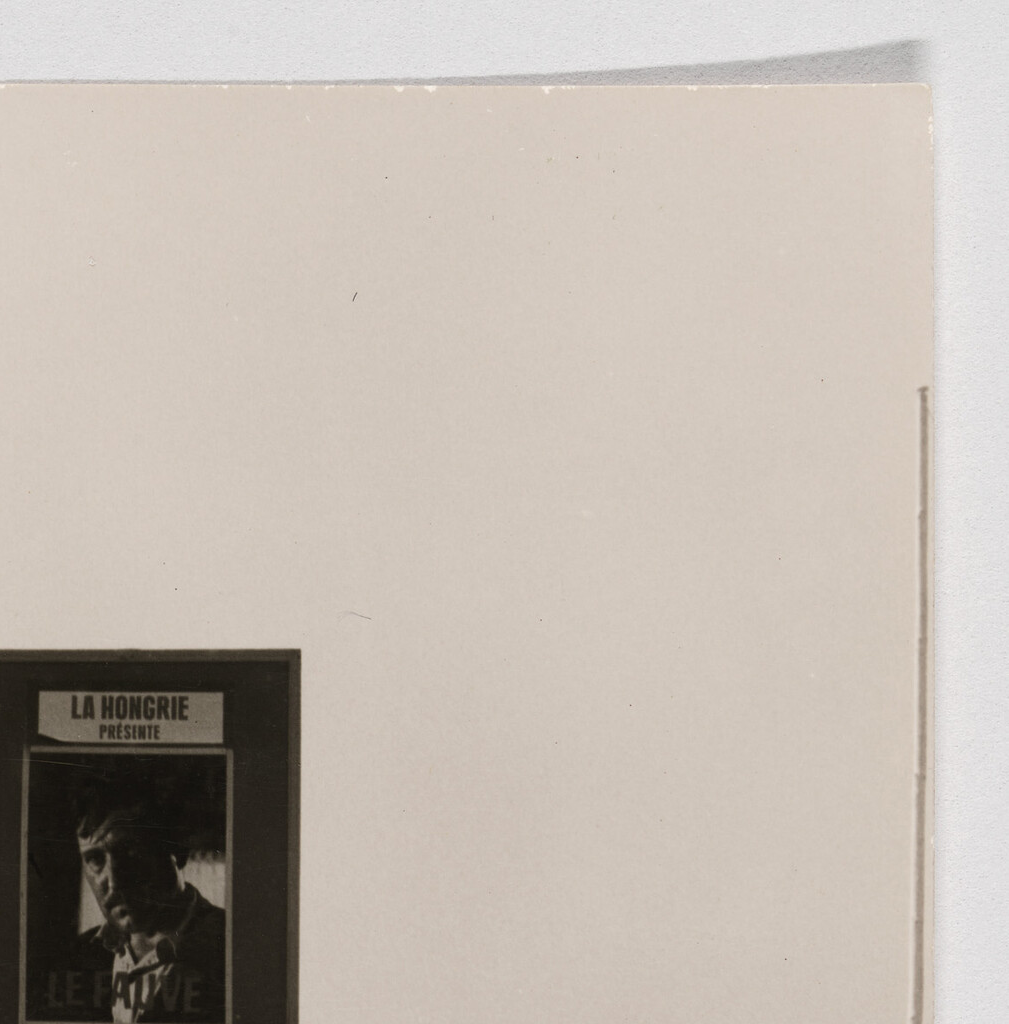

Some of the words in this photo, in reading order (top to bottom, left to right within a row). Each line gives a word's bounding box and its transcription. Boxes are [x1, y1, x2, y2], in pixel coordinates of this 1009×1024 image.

[71, 695, 95, 720] LA
[101, 695, 189, 721] HONGRIE
[47, 971, 84, 1008] LE
[93, 971, 202, 1013] FAUVE
